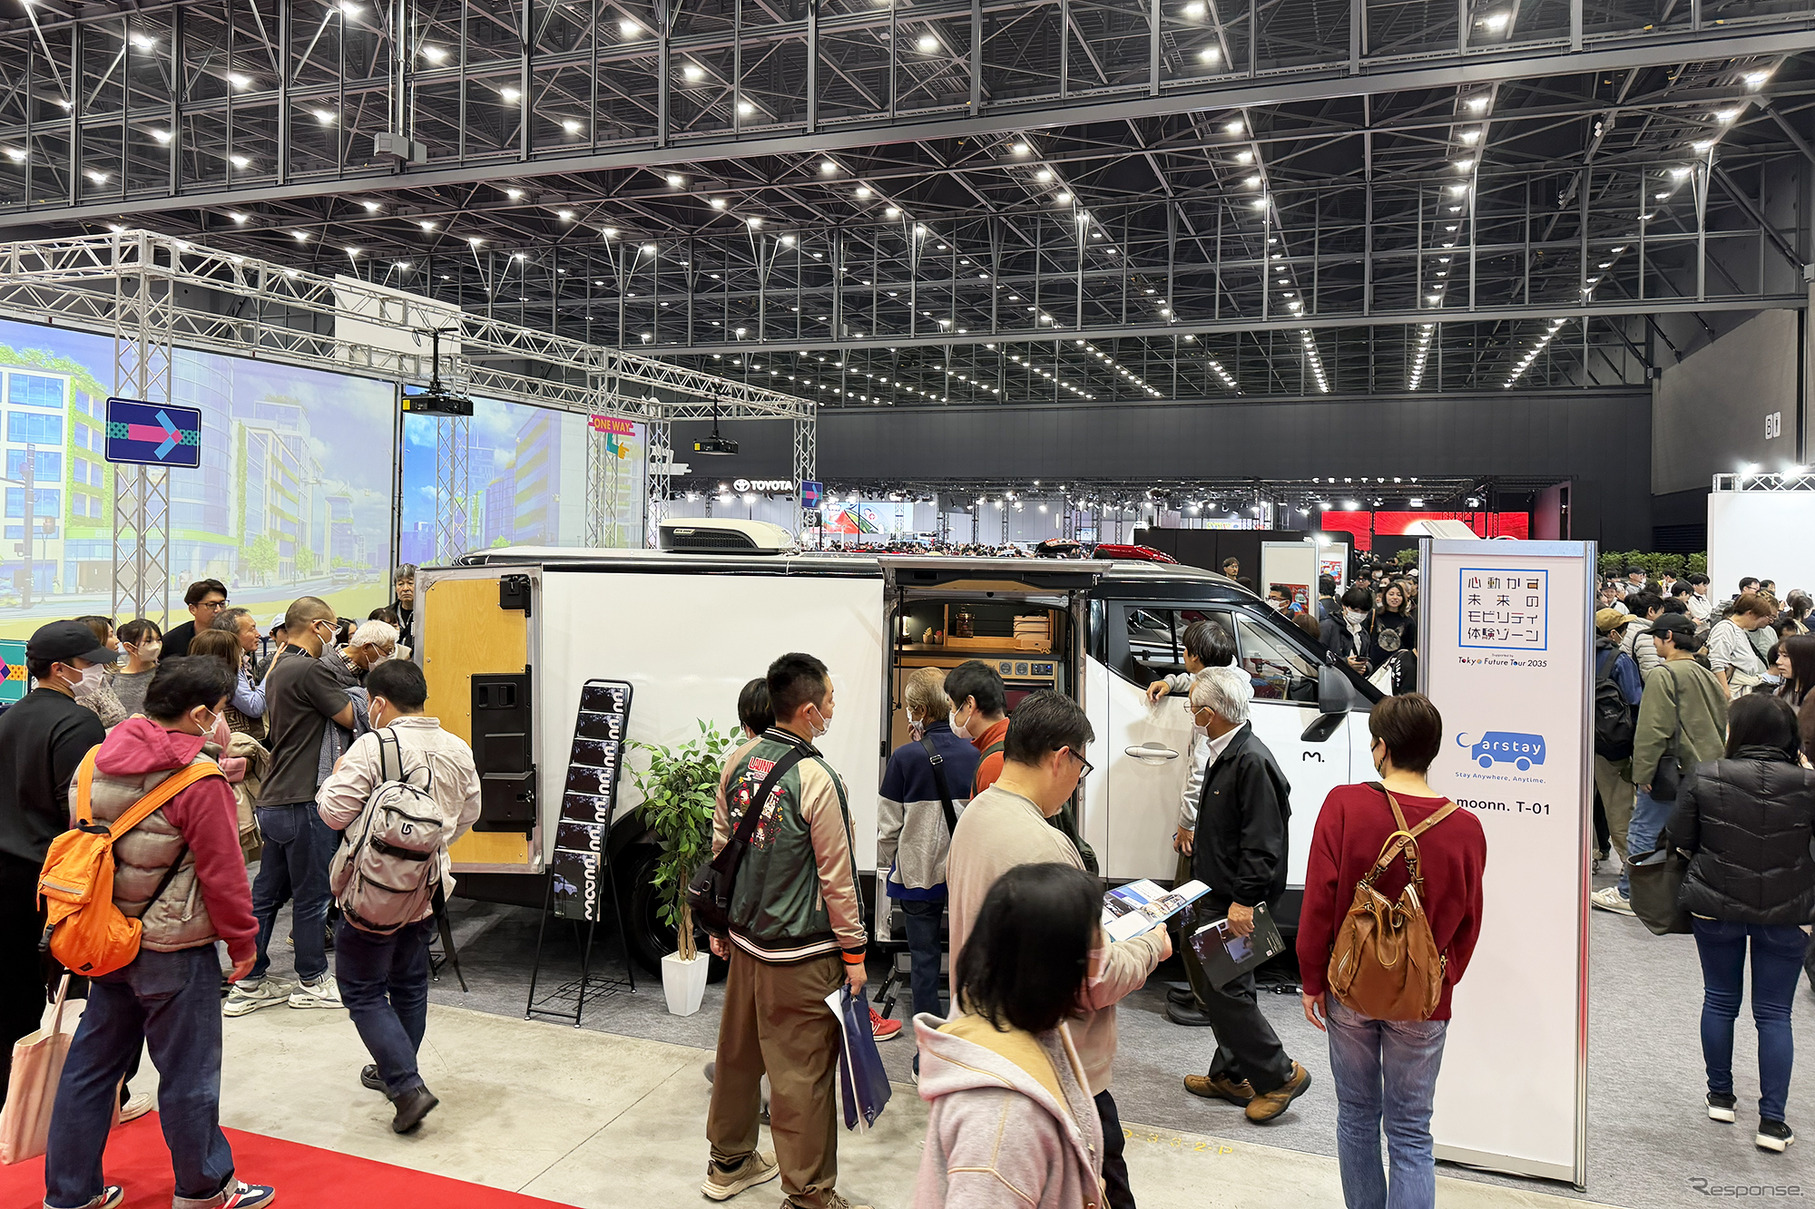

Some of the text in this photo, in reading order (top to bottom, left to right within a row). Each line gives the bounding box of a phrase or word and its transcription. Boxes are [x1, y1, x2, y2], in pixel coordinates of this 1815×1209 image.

[594, 418, 630, 432] ONE WAY
[750, 480, 793, 491] TOYOTA
[1468, 594, 1539, 608] 未来の
[1468, 610, 1538, 624] モビリティ
[1468, 627, 1539, 642] 体験ゾーン
[1458, 656, 1482, 666] Tokyo
[1484, 658, 1508, 666] Future
[1473, 773, 1511, 782] Anywhere,
[1513, 776, 1546, 784] Anytime.
[1457, 798, 1550, 815] moonn. T-01
